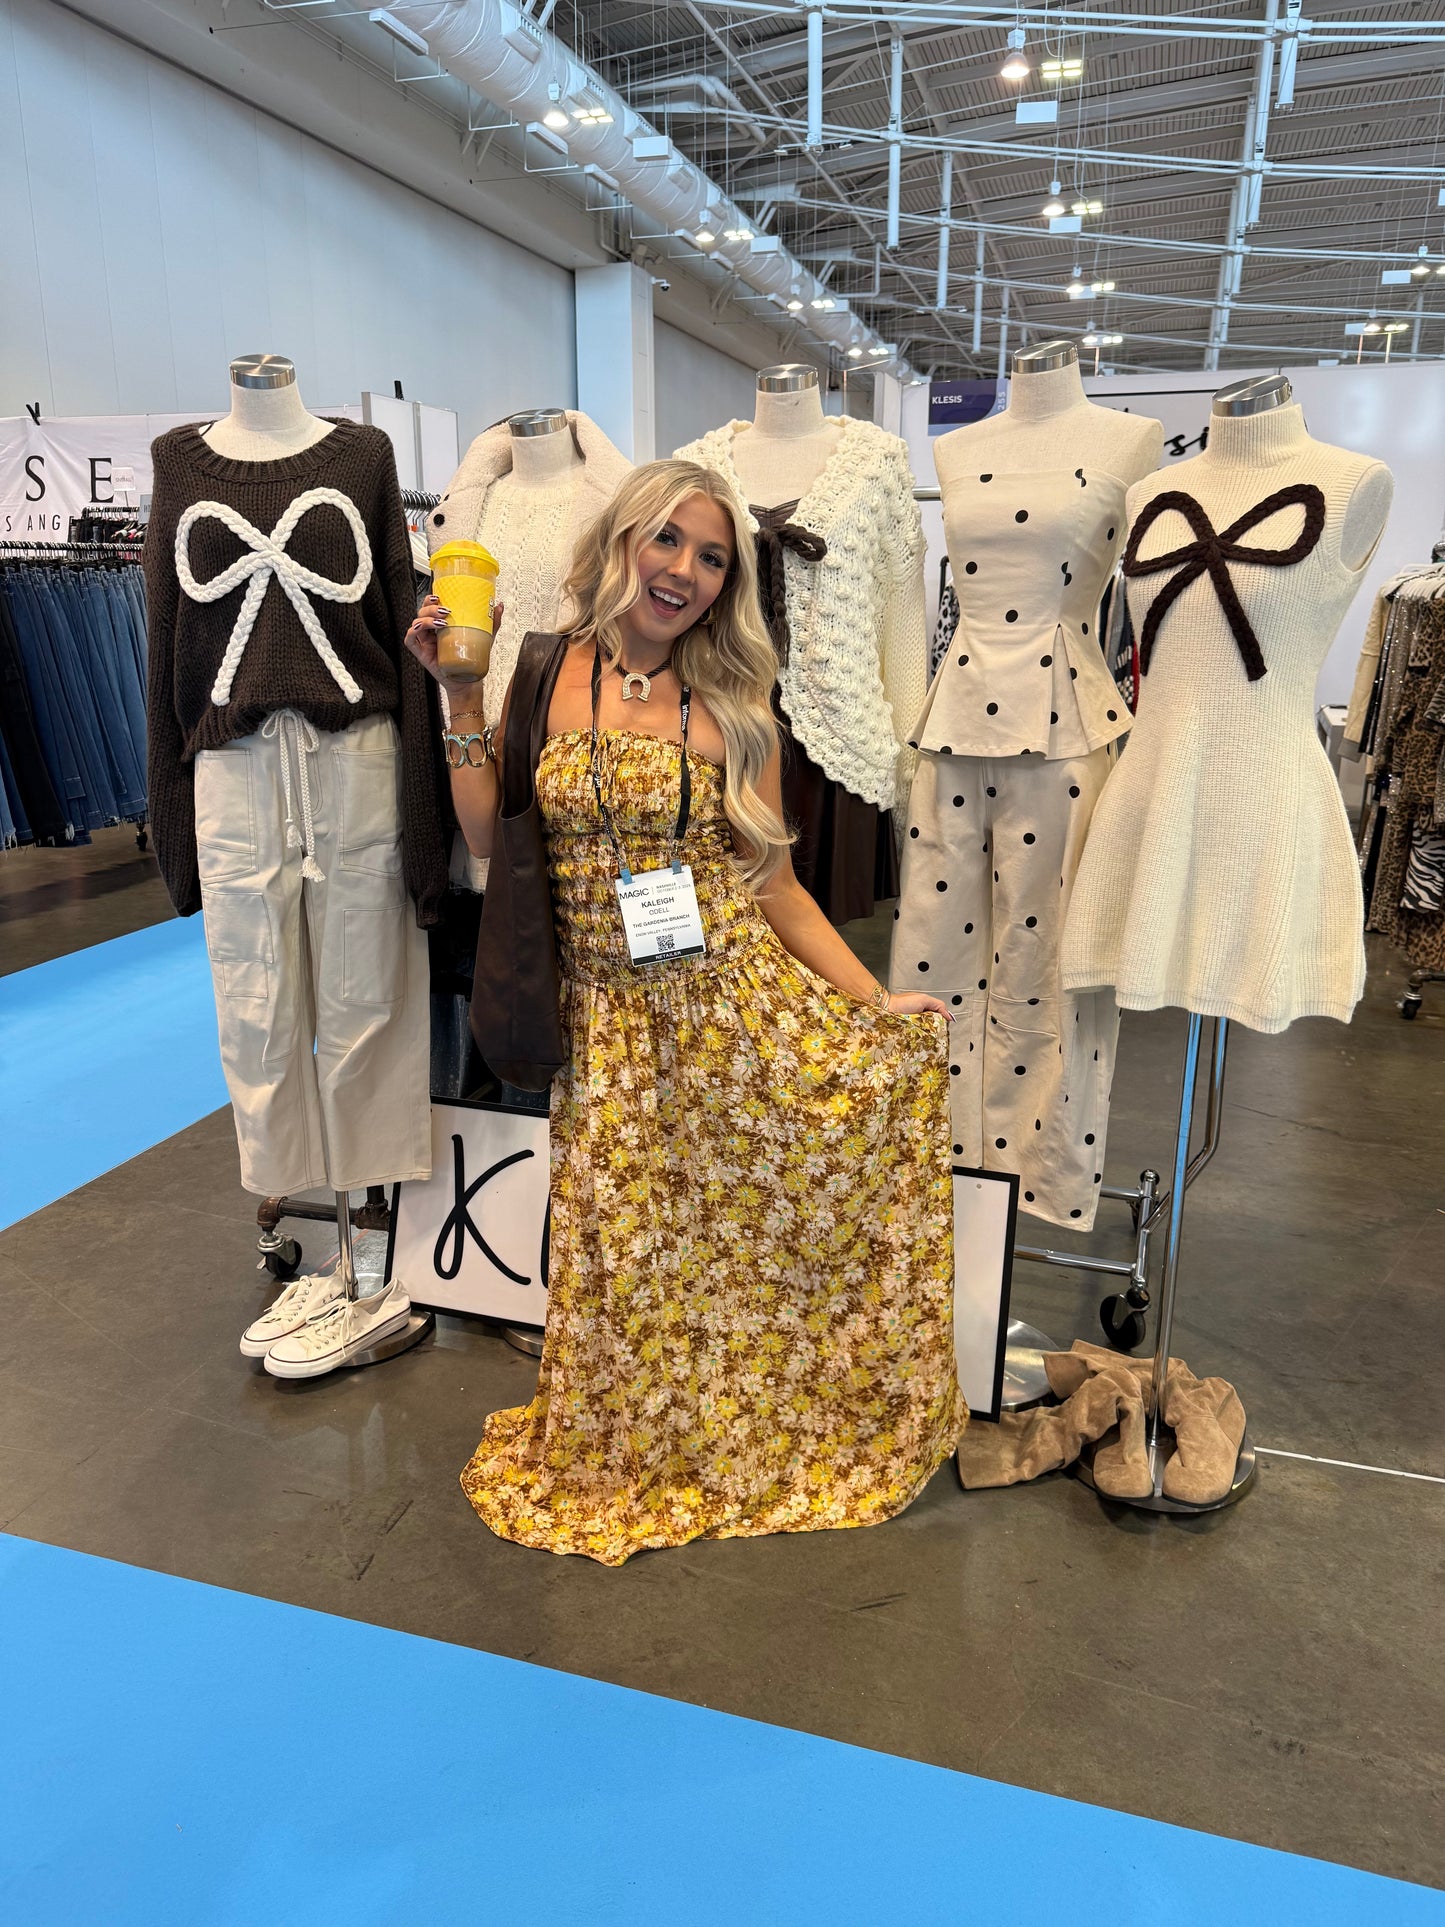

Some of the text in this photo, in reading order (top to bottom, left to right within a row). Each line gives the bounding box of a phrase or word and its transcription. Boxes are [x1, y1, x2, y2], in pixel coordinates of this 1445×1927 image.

[931, 395, 962, 405] KLESIS
[997, 391, 1006, 411] 255
[619, 888, 650, 900] MAGIC
[641, 896, 675, 908] KALEIGH
[649, 907, 670, 916] ODELL
[643, 918, 669, 927] GARDENIA
[669, 914, 690, 922] BRANCH
[655, 951, 682, 960] RETAILER
